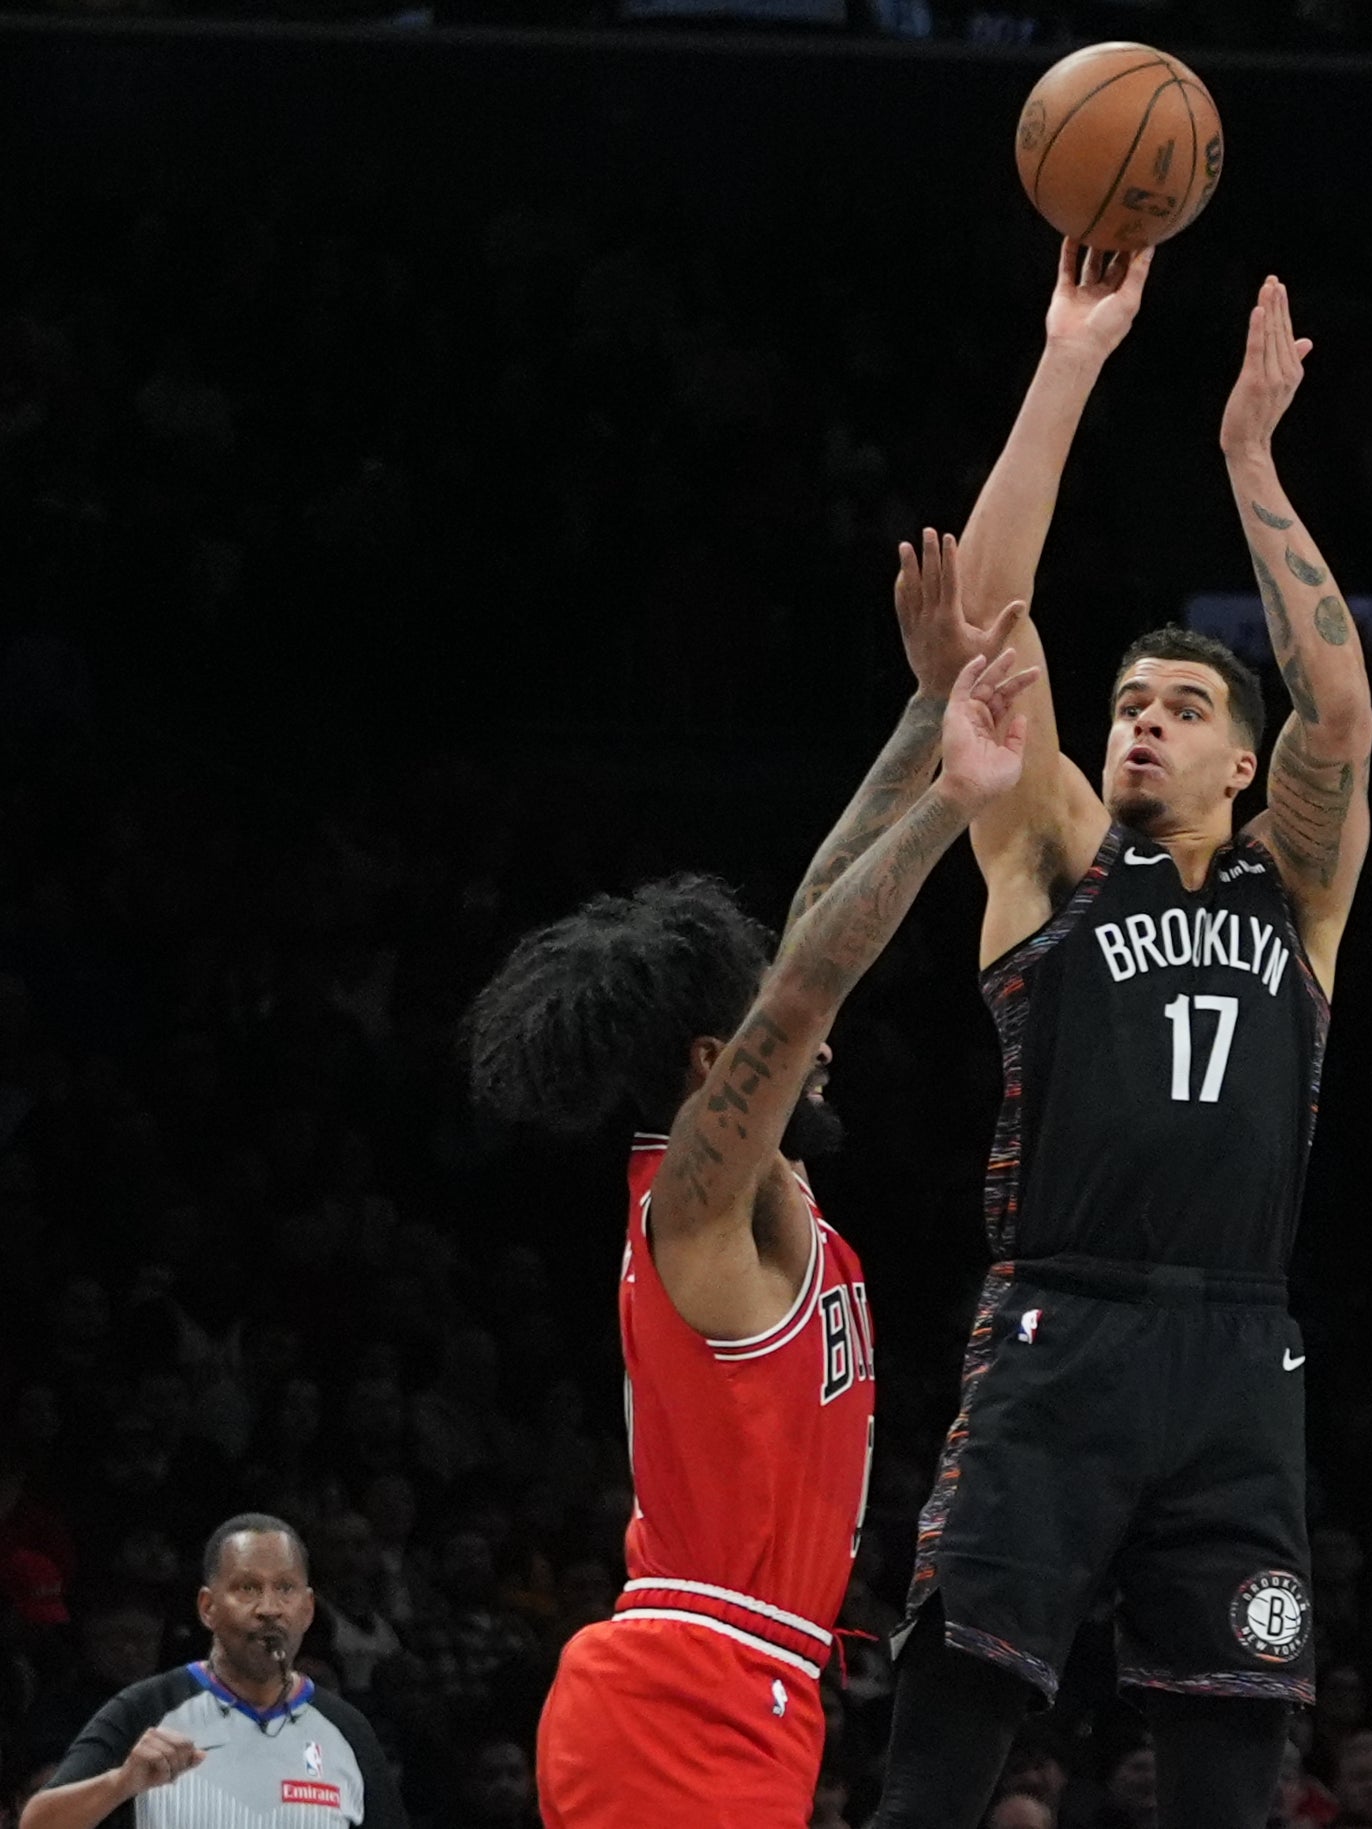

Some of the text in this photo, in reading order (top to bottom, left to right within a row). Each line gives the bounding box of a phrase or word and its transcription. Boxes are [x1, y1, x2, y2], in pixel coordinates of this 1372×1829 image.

[1095, 907, 1289, 996] BROOKLYN
[1164, 993, 1239, 1102] 17
[1267, 1596, 1284, 1636] B
